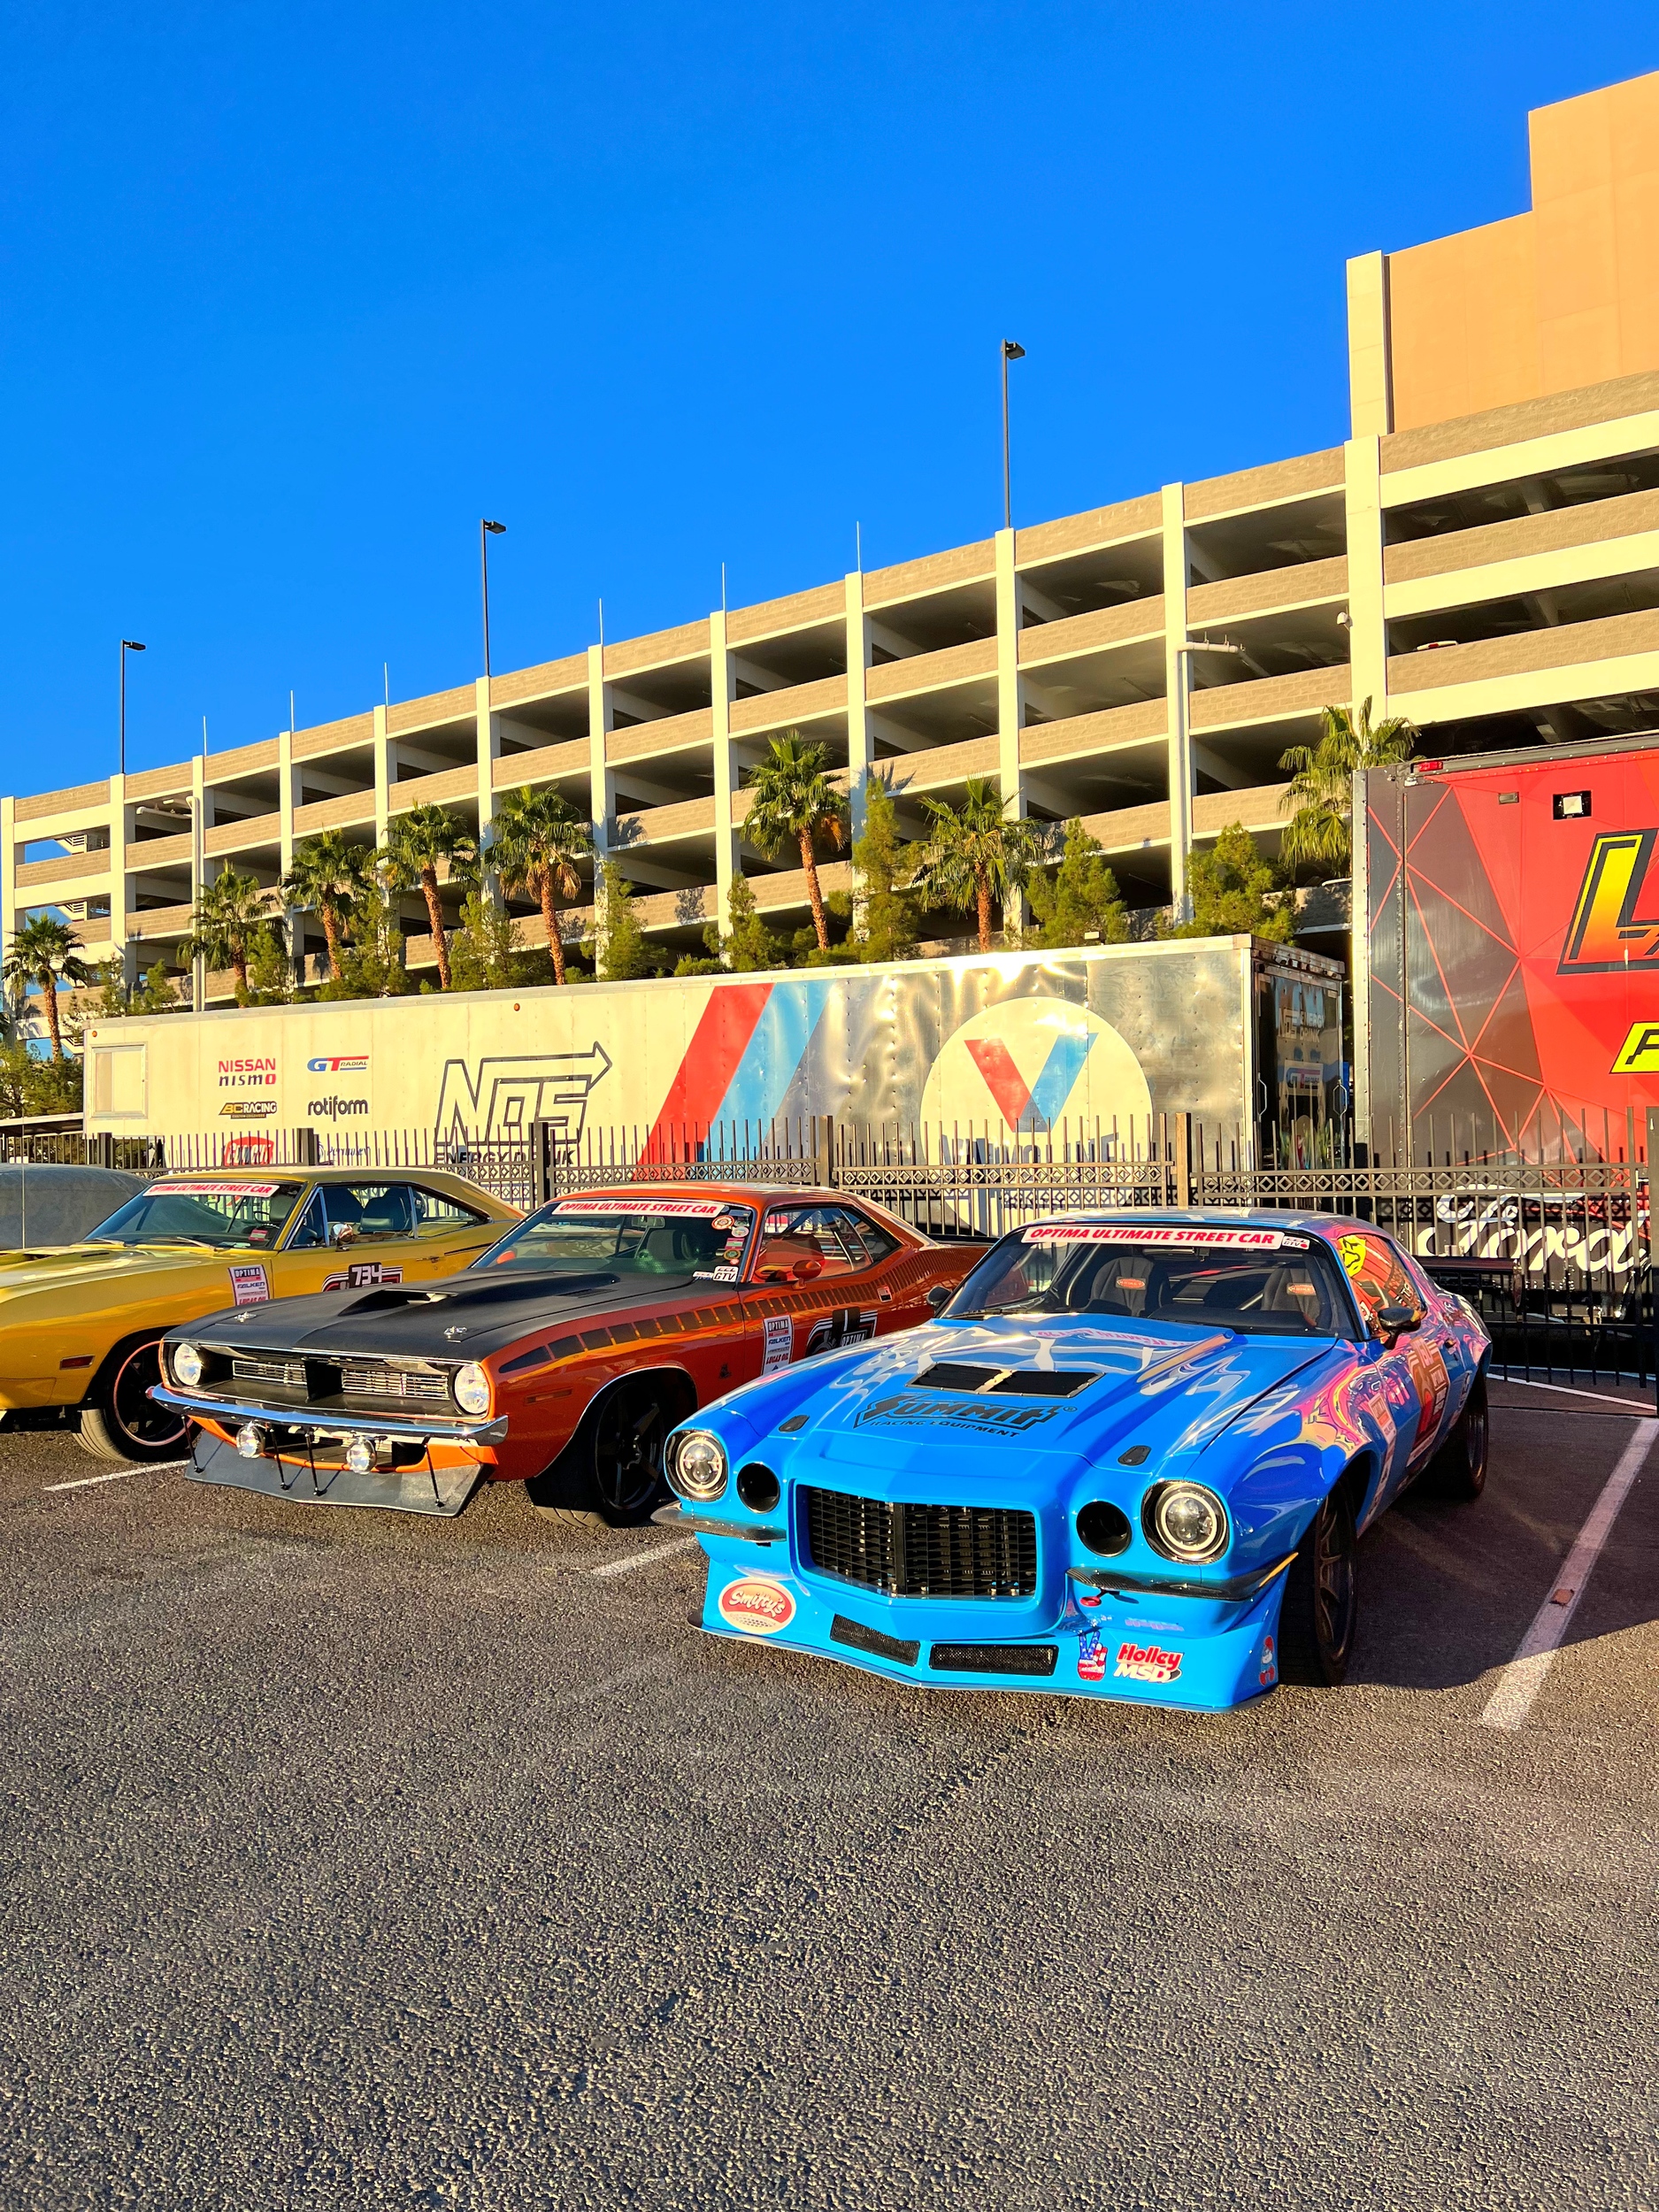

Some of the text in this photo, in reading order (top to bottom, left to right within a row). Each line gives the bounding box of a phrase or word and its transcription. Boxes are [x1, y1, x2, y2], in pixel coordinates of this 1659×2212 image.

[1300, 1026, 1319, 1042] DRINK
[219, 1058, 276, 1072] NISSAN
[434, 1053, 603, 1146] NOS
[220, 1102, 276, 1113] BC RACING
[307, 1094, 368, 1122] rotiform
[597, 1202, 649, 1212] ULTIMATE
[649, 1204, 693, 1213] STREET
[691, 1204, 718, 1214] CAR
[1030, 1229, 1091, 1238] OPTIMA
[1092, 1229, 1173, 1240] ULTIMATE
[1174, 1231, 1237, 1242] STREET
[1239, 1233, 1275, 1244] CAR
[234, 1268, 260, 1278] OPTIMA
[351, 1264, 382, 1285] 734
[768, 1319, 788, 1332] OPTIMA
[768, 1336, 791, 1345] FALKEN
[841, 1333, 865, 1346] OPTIMA
[929, 1420, 1020, 1438] EQUIPMENT
[728, 1590, 787, 1618] Smitty's
[1118, 1643, 1182, 1671] Holley
[1113, 1663, 1173, 1683] MSD
